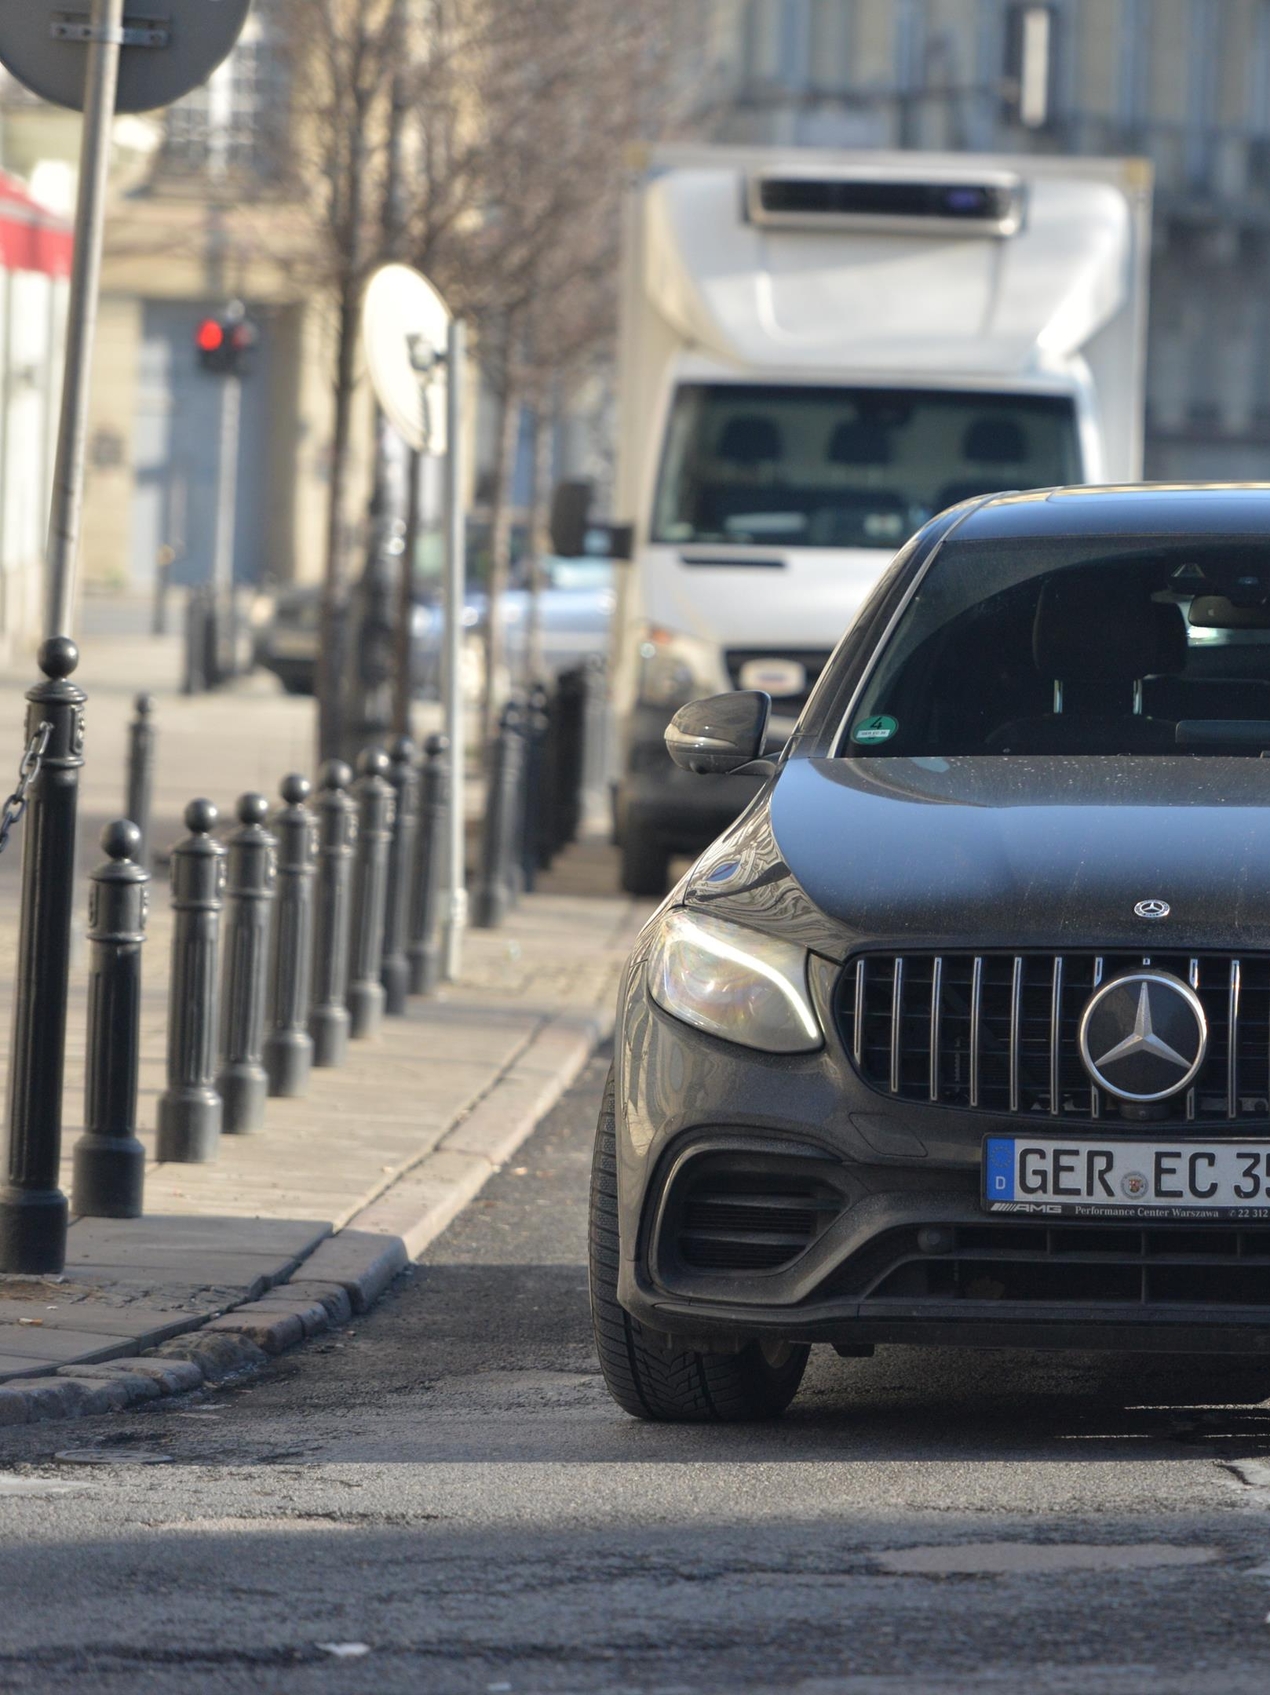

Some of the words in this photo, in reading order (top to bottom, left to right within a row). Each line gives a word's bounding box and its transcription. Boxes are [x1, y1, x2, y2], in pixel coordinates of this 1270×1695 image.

[870, 716, 882, 729] 4
[1019, 1148, 1116, 1197] GER
[1154, 1151, 1218, 1199] EC
[995, 1175, 1007, 1190] D
[1075, 1205, 1135, 1217] Performance
[1137, 1207, 1169, 1217] Center
[1172, 1208, 1219, 1218] Warszawa
[1237, 1208, 1250, 1218] 22
[1252, 1208, 1269, 1218] 312
